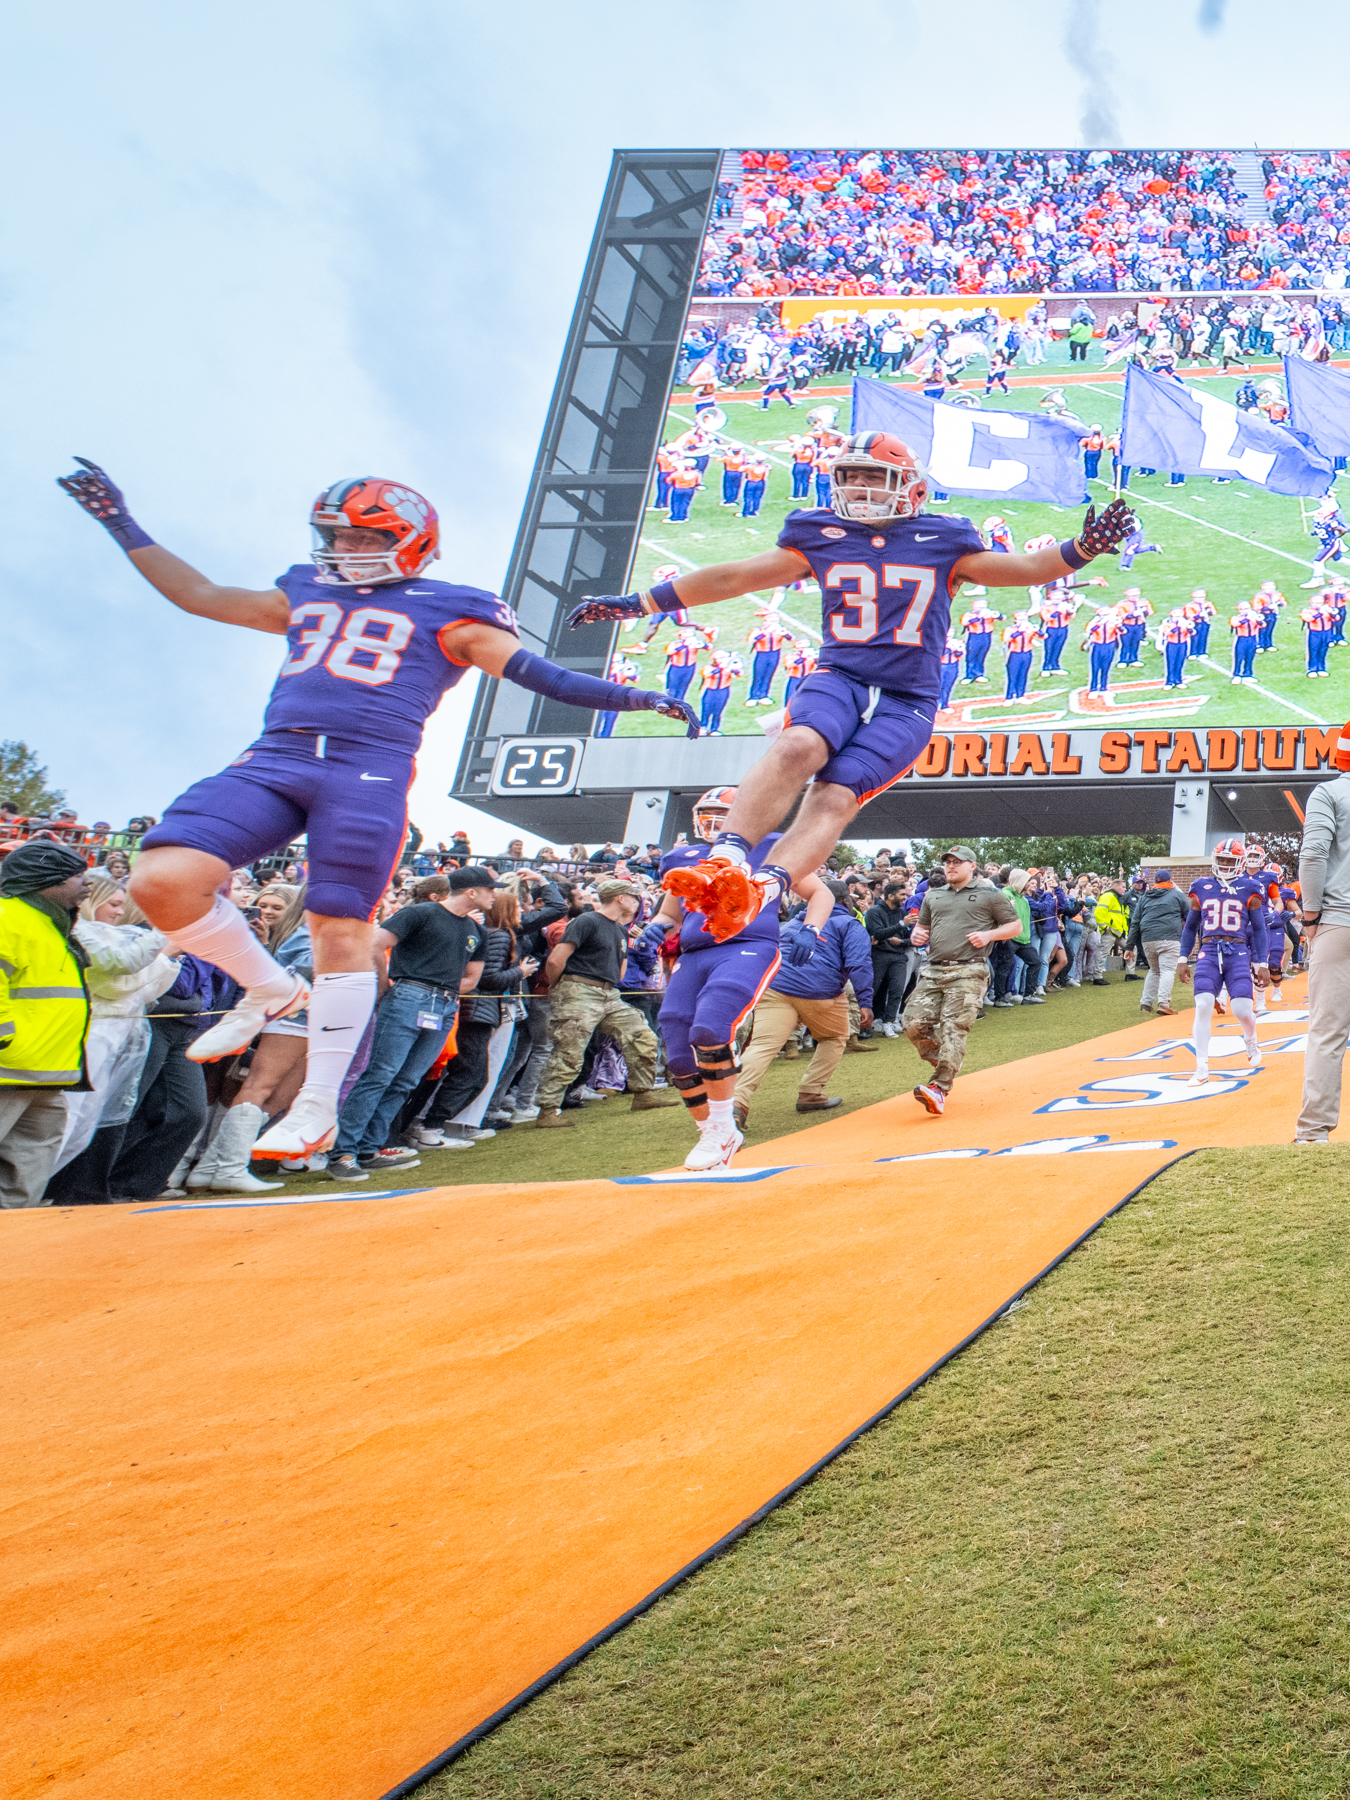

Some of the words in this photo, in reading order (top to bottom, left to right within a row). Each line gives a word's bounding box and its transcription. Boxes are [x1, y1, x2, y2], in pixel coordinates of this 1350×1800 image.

[825, 562, 937, 646] 37
[280, 602, 416, 687] 38
[507, 748, 567, 786] 25
[914, 732, 1082, 778] ORIAL
[1099, 727, 1344, 774] STADIUM
[968, 894, 977, 902] C
[1202, 898, 1243, 932] 36
